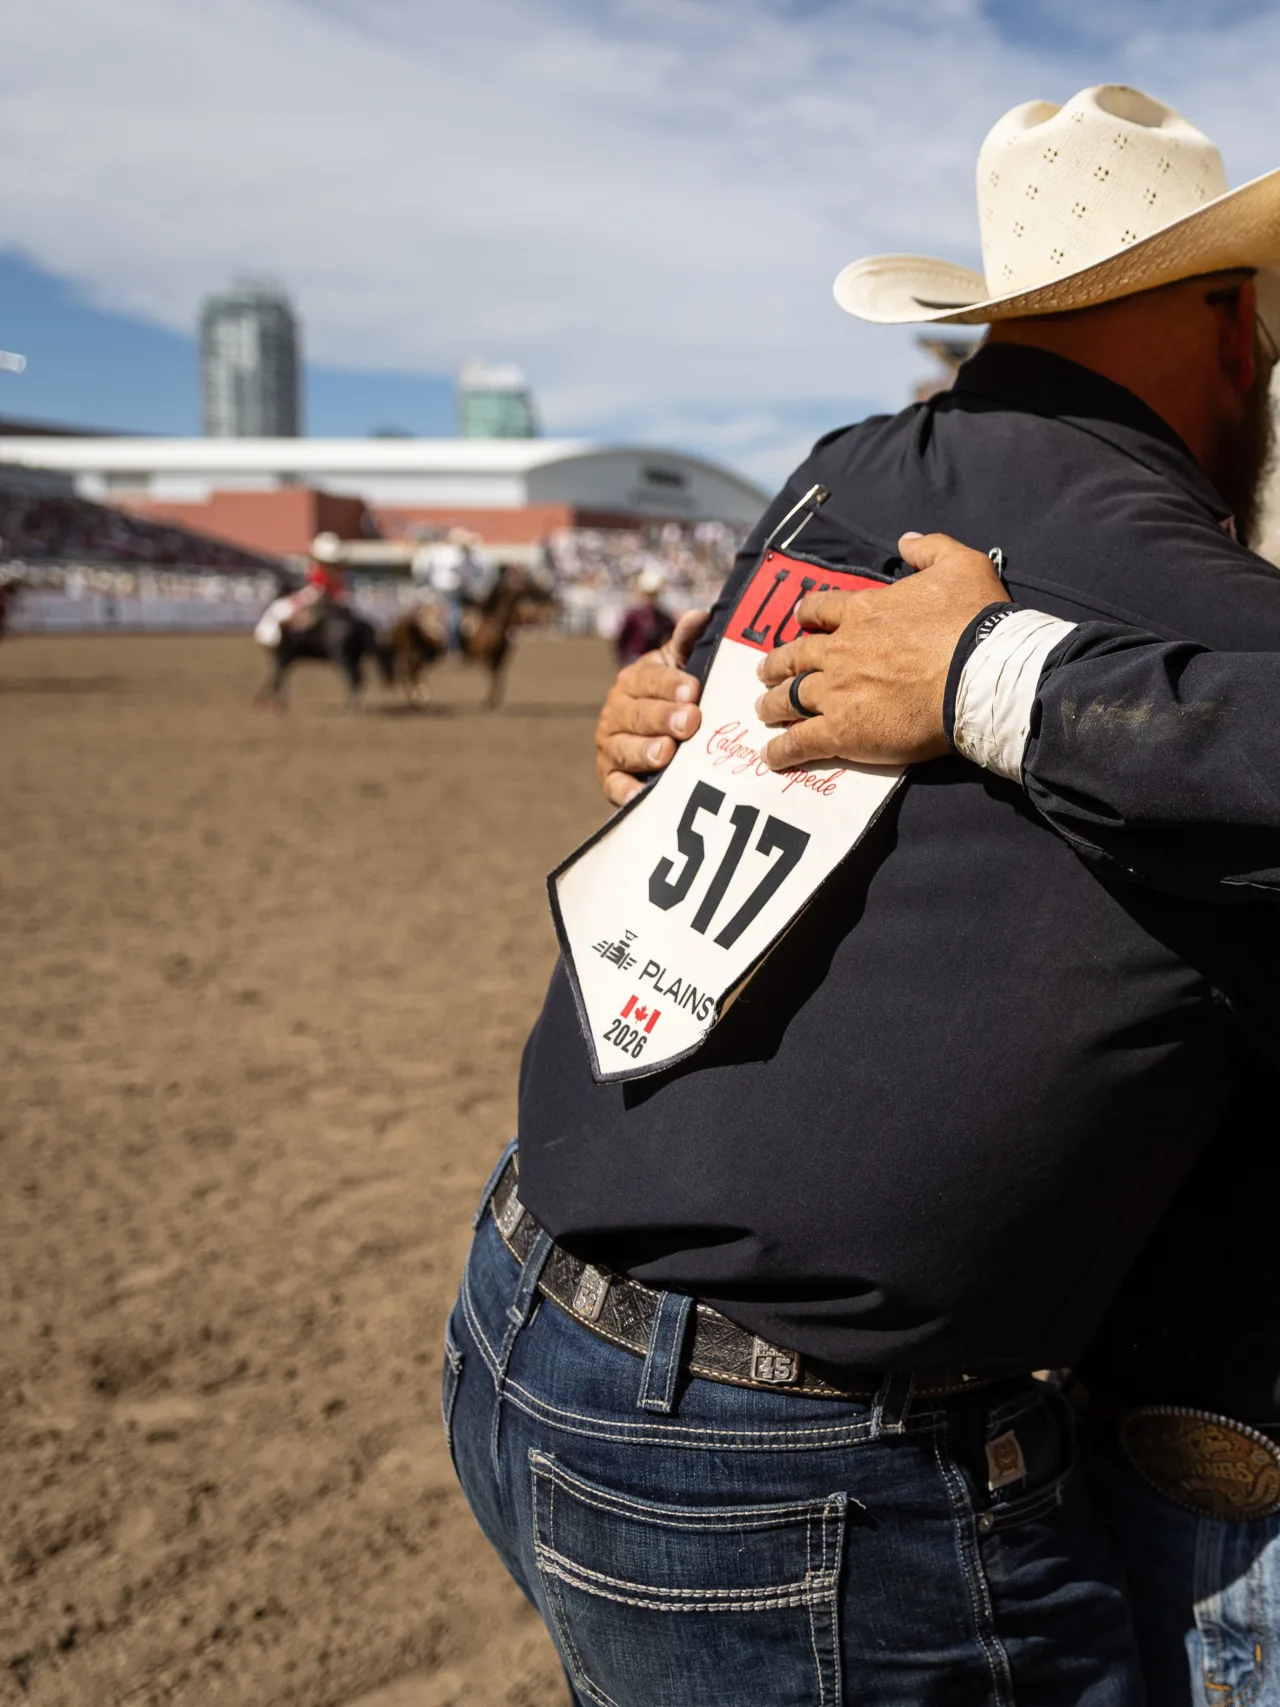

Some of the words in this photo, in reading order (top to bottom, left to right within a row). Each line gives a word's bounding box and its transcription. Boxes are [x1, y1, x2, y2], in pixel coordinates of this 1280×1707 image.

[706, 720, 763, 775] Calgary
[649, 780, 811, 951] 517
[638, 959, 716, 1022] PLAINS
[602, 1018, 649, 1059] 2026
